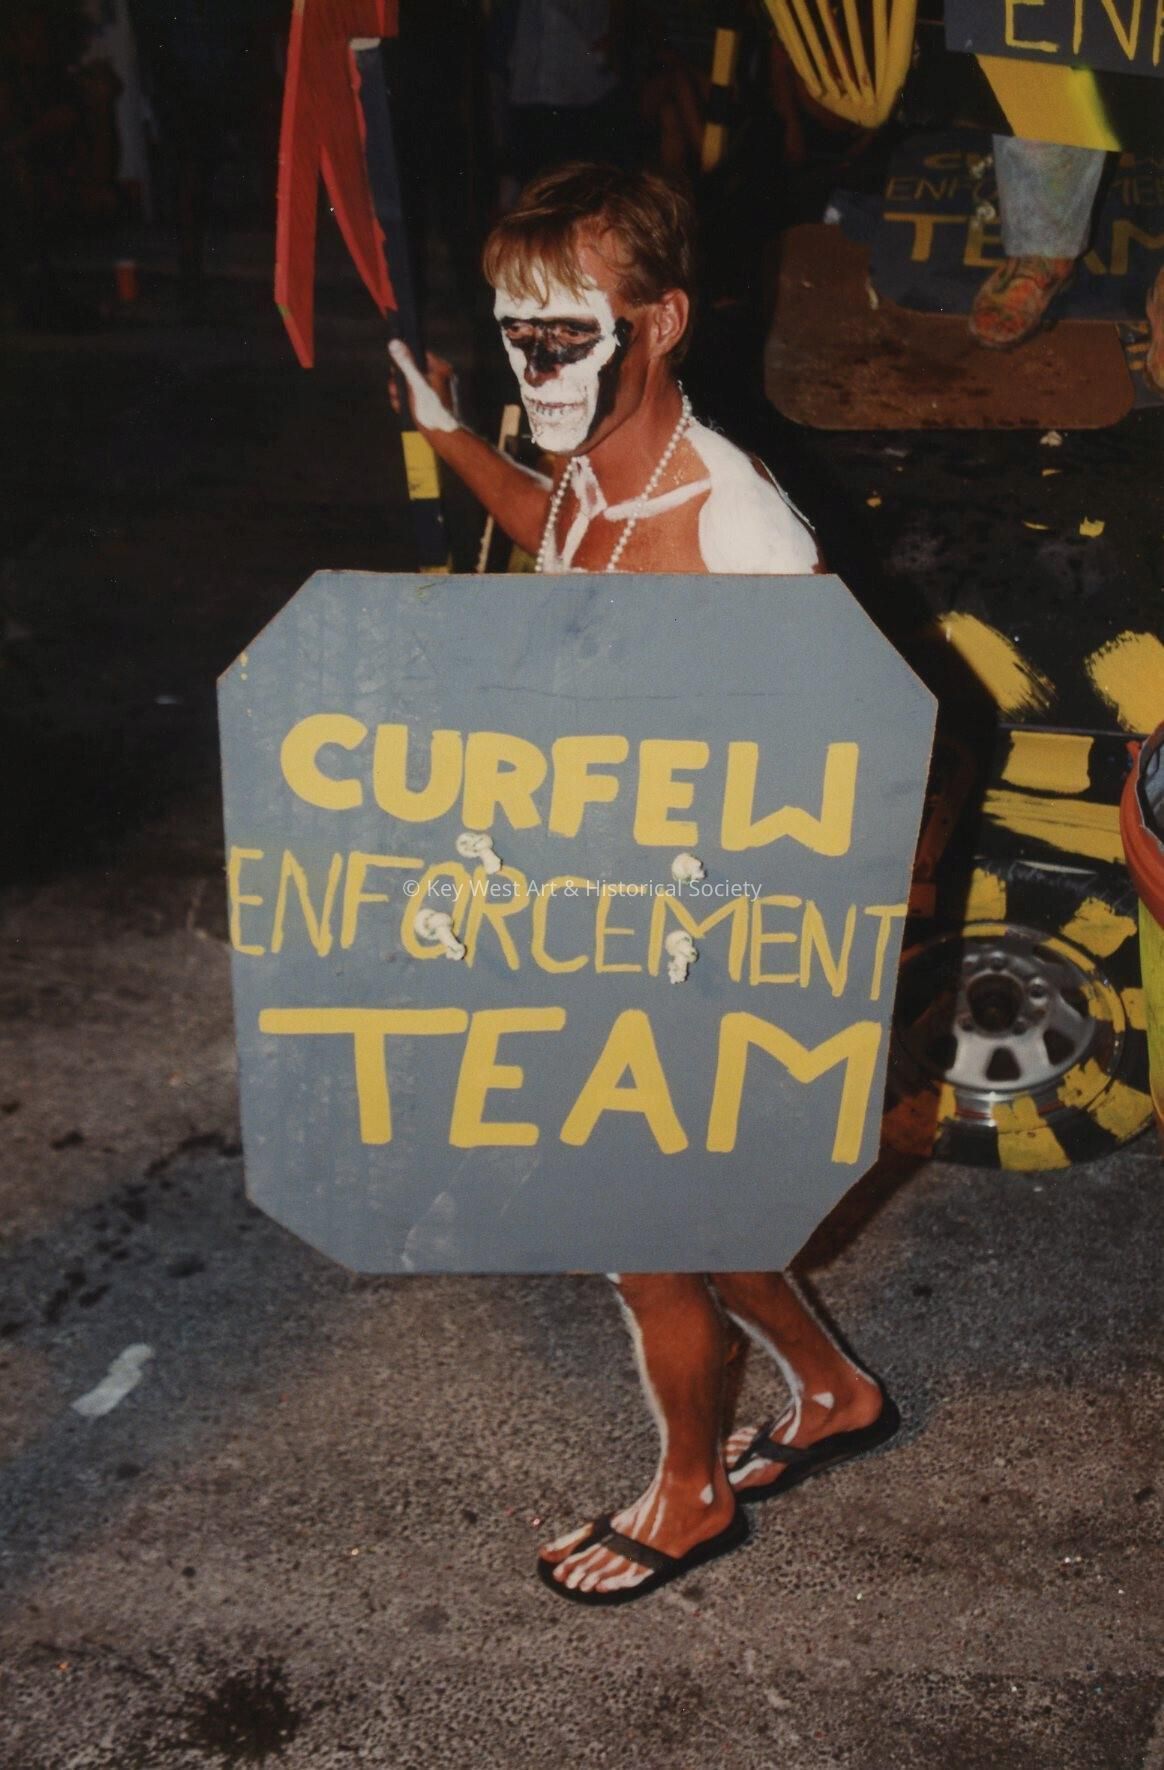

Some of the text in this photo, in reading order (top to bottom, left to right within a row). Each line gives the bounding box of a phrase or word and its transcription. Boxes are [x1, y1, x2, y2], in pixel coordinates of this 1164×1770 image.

[280, 713, 859, 857] CURFEW
[228, 846, 908, 1001] ENFORCEMENT
[259, 1007, 882, 1165] TEAM
